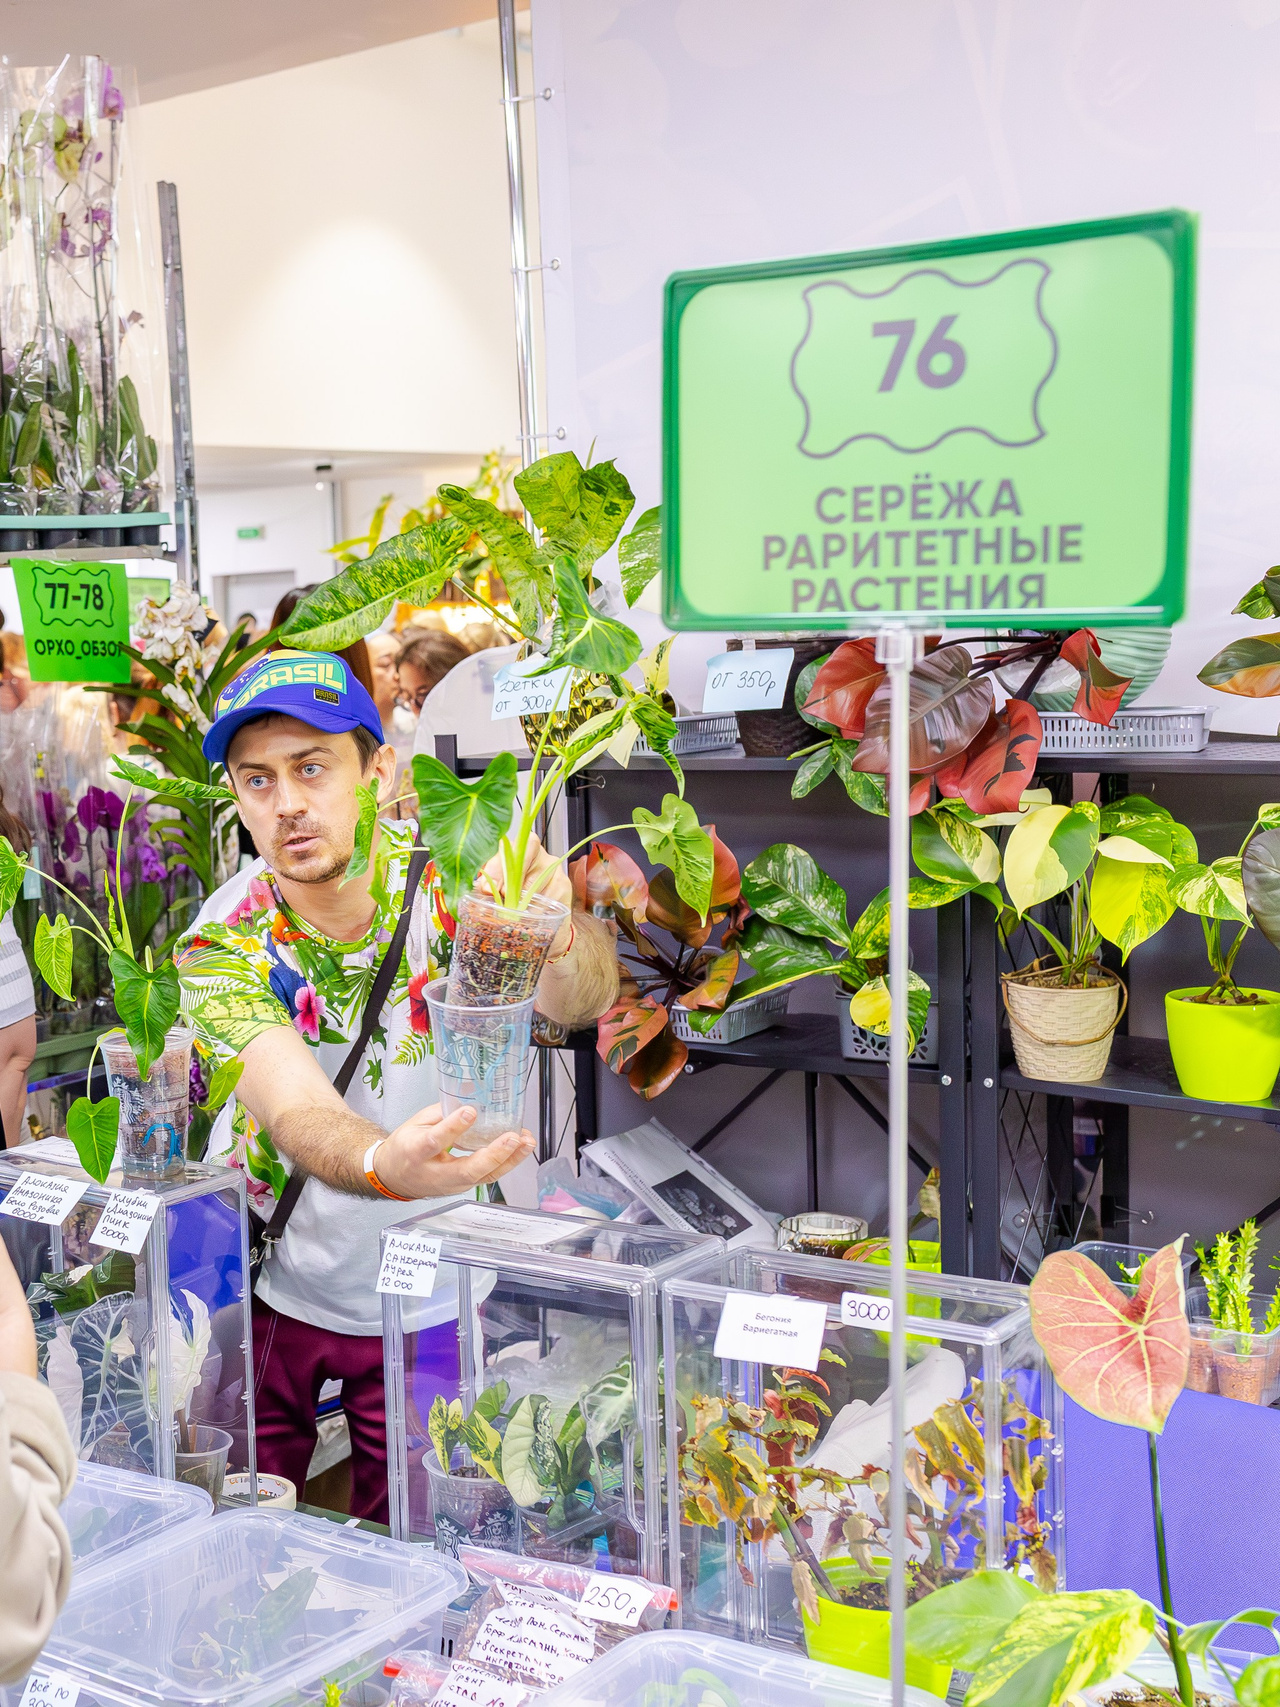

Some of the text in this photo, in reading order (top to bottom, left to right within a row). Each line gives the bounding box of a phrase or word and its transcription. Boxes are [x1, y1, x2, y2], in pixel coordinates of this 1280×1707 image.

[872, 313, 968, 394] 76
[814, 473, 1024, 525] СЕРЁЖА
[762, 524, 1084, 572] РАРИТЕТНЫЕ
[44, 582, 104, 611] 77-78
[791, 573, 1047, 613] РАСТЕНИЯ
[736, 670, 777, 698] 350р
[754, 1312, 792, 1325] Бегония
[583, 1586, 637, 1619] 250р
